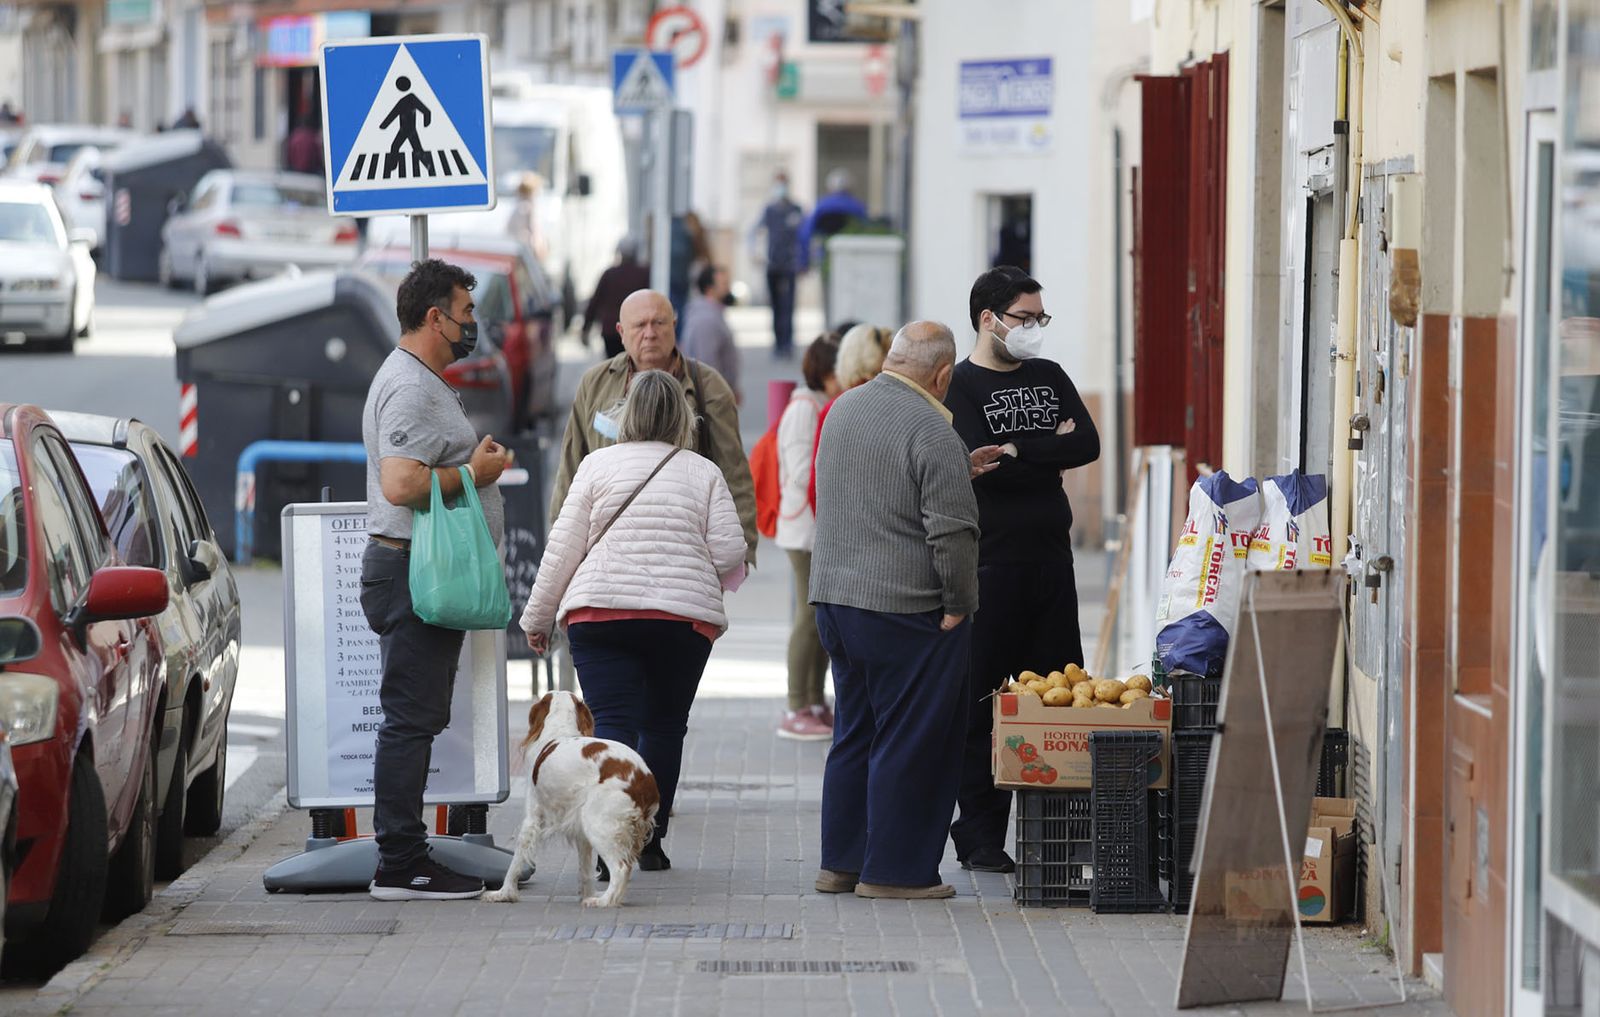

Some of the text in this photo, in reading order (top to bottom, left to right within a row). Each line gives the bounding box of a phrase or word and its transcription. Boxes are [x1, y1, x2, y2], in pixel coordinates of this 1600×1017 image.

[984, 386, 1059, 414] STAR
[986, 407, 1059, 434] WARS
[335, 550, 341, 560] 3
[336, 565, 342, 574] 3
[1203, 541, 1224, 606] TORCAL
[336, 580, 342, 589] 3
[337, 594, 343, 604] 3
[336, 608, 343, 618] 3
[337, 622, 343, 633] 3
[337, 637, 344, 647] 3
[337, 652, 344, 662] 3
[337, 667, 344, 677] 4
